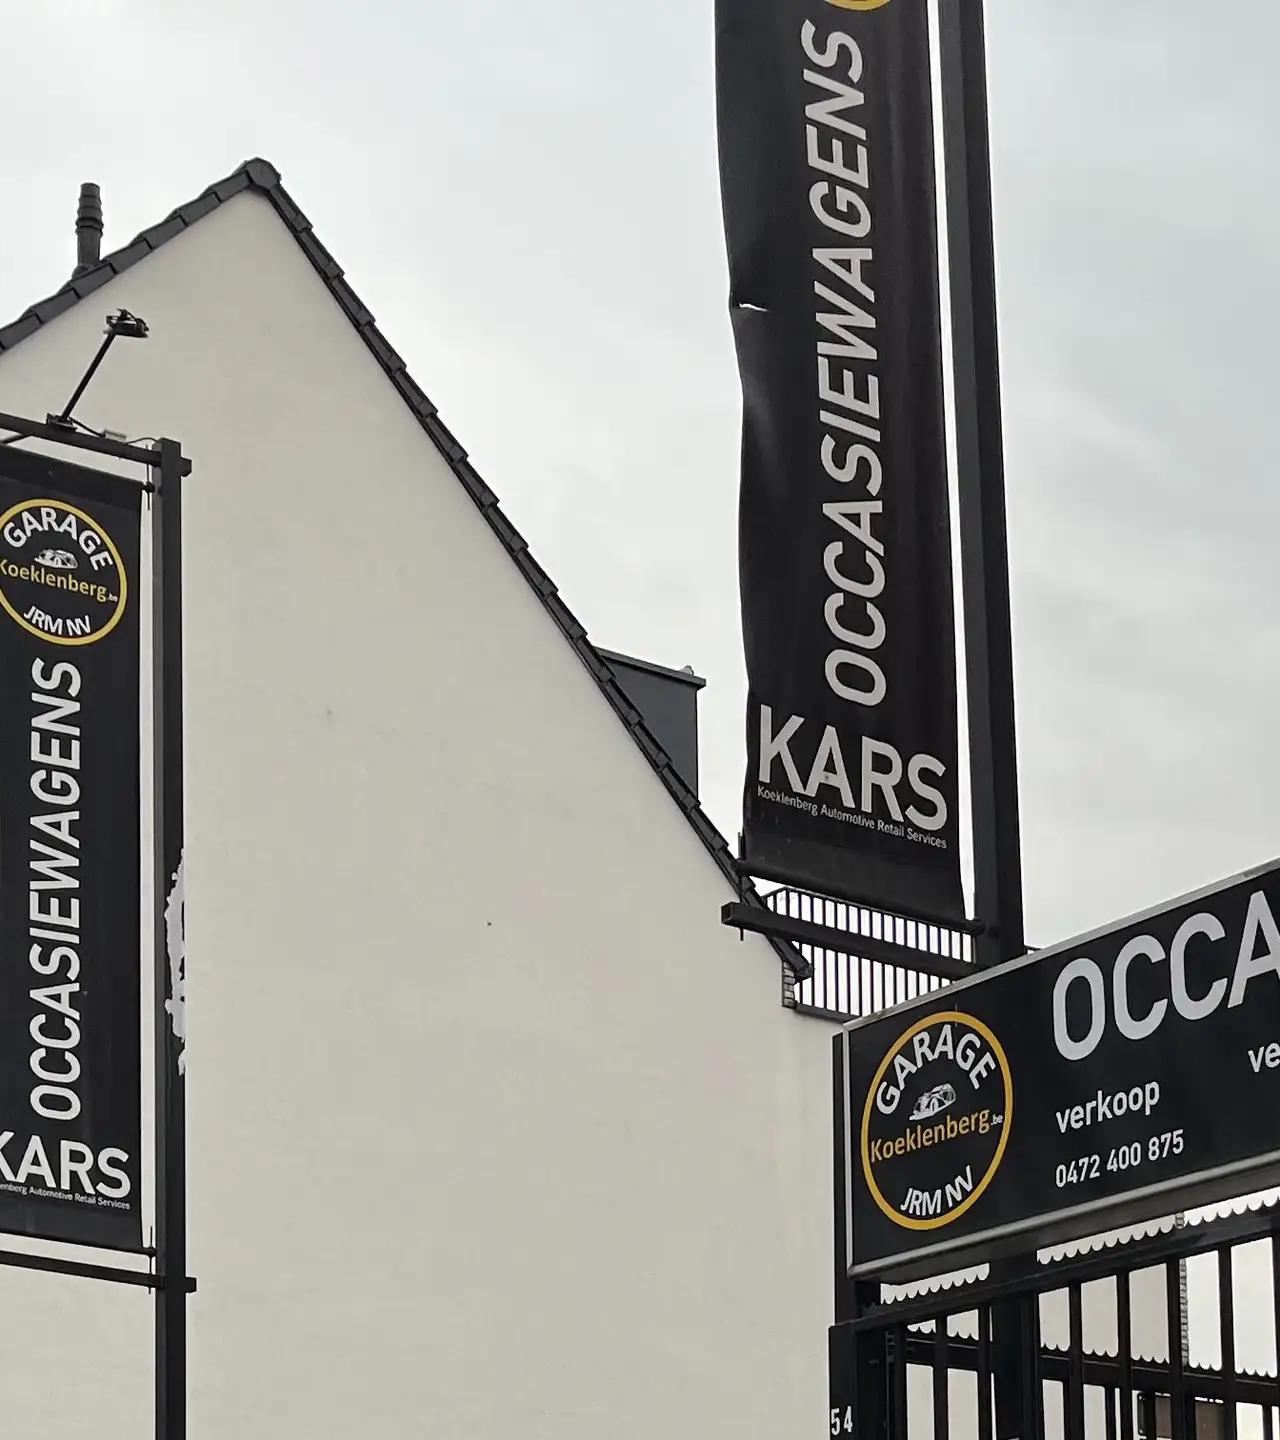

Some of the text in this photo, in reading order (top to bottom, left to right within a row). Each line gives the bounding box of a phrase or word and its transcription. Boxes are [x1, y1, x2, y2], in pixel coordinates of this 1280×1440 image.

[801, 19, 887, 707] OCCASIEWAGENS
[4, 507, 113, 570] GARAGE
[24, 605, 91, 636] JRM NV
[758, 705, 947, 831] KARS
[757, 785, 947, 849] Koeklenberg Automotive Retail Services
[29, 657, 81, 1120] OCCASIEWAGENS
[876, 1024, 996, 1114] GARAGE
[1056, 1081, 1160, 1133] verkoop
[1056, 1129, 1184, 1188] 0472 400 875
[900, 1165, 974, 1216] JRM NV
[831, 1405, 853, 1436] 54
